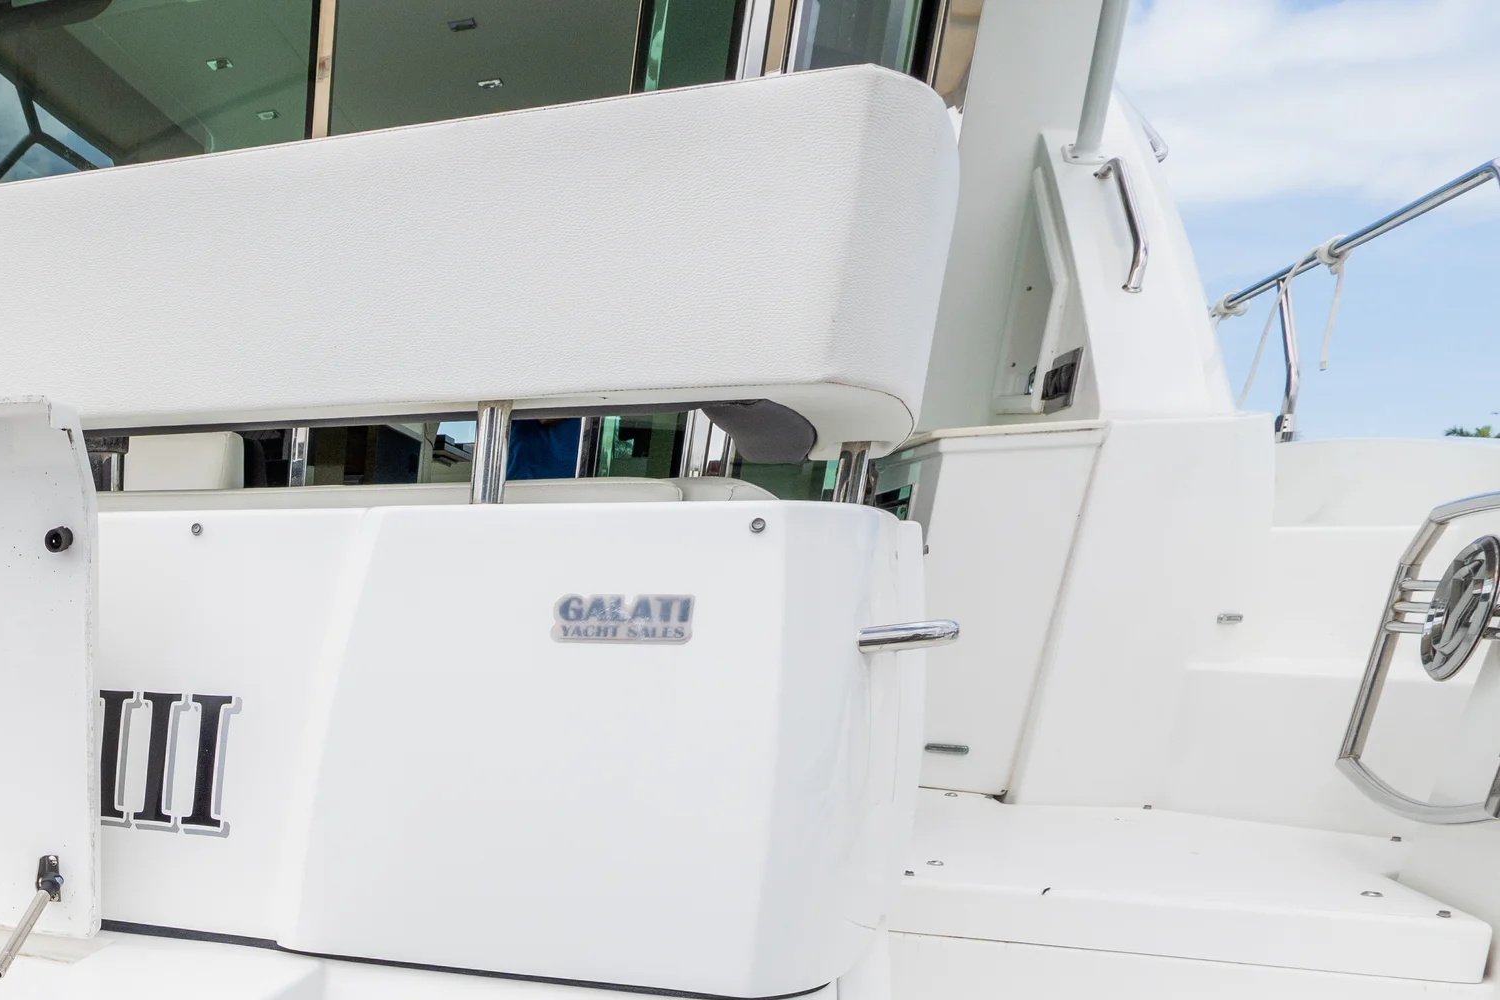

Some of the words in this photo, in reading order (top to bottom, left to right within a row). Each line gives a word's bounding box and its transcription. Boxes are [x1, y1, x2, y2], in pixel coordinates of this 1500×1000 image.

[558, 595, 692, 623] GALATI
[560, 624, 619, 638] YACHT
[626, 625, 685, 640] SALES
